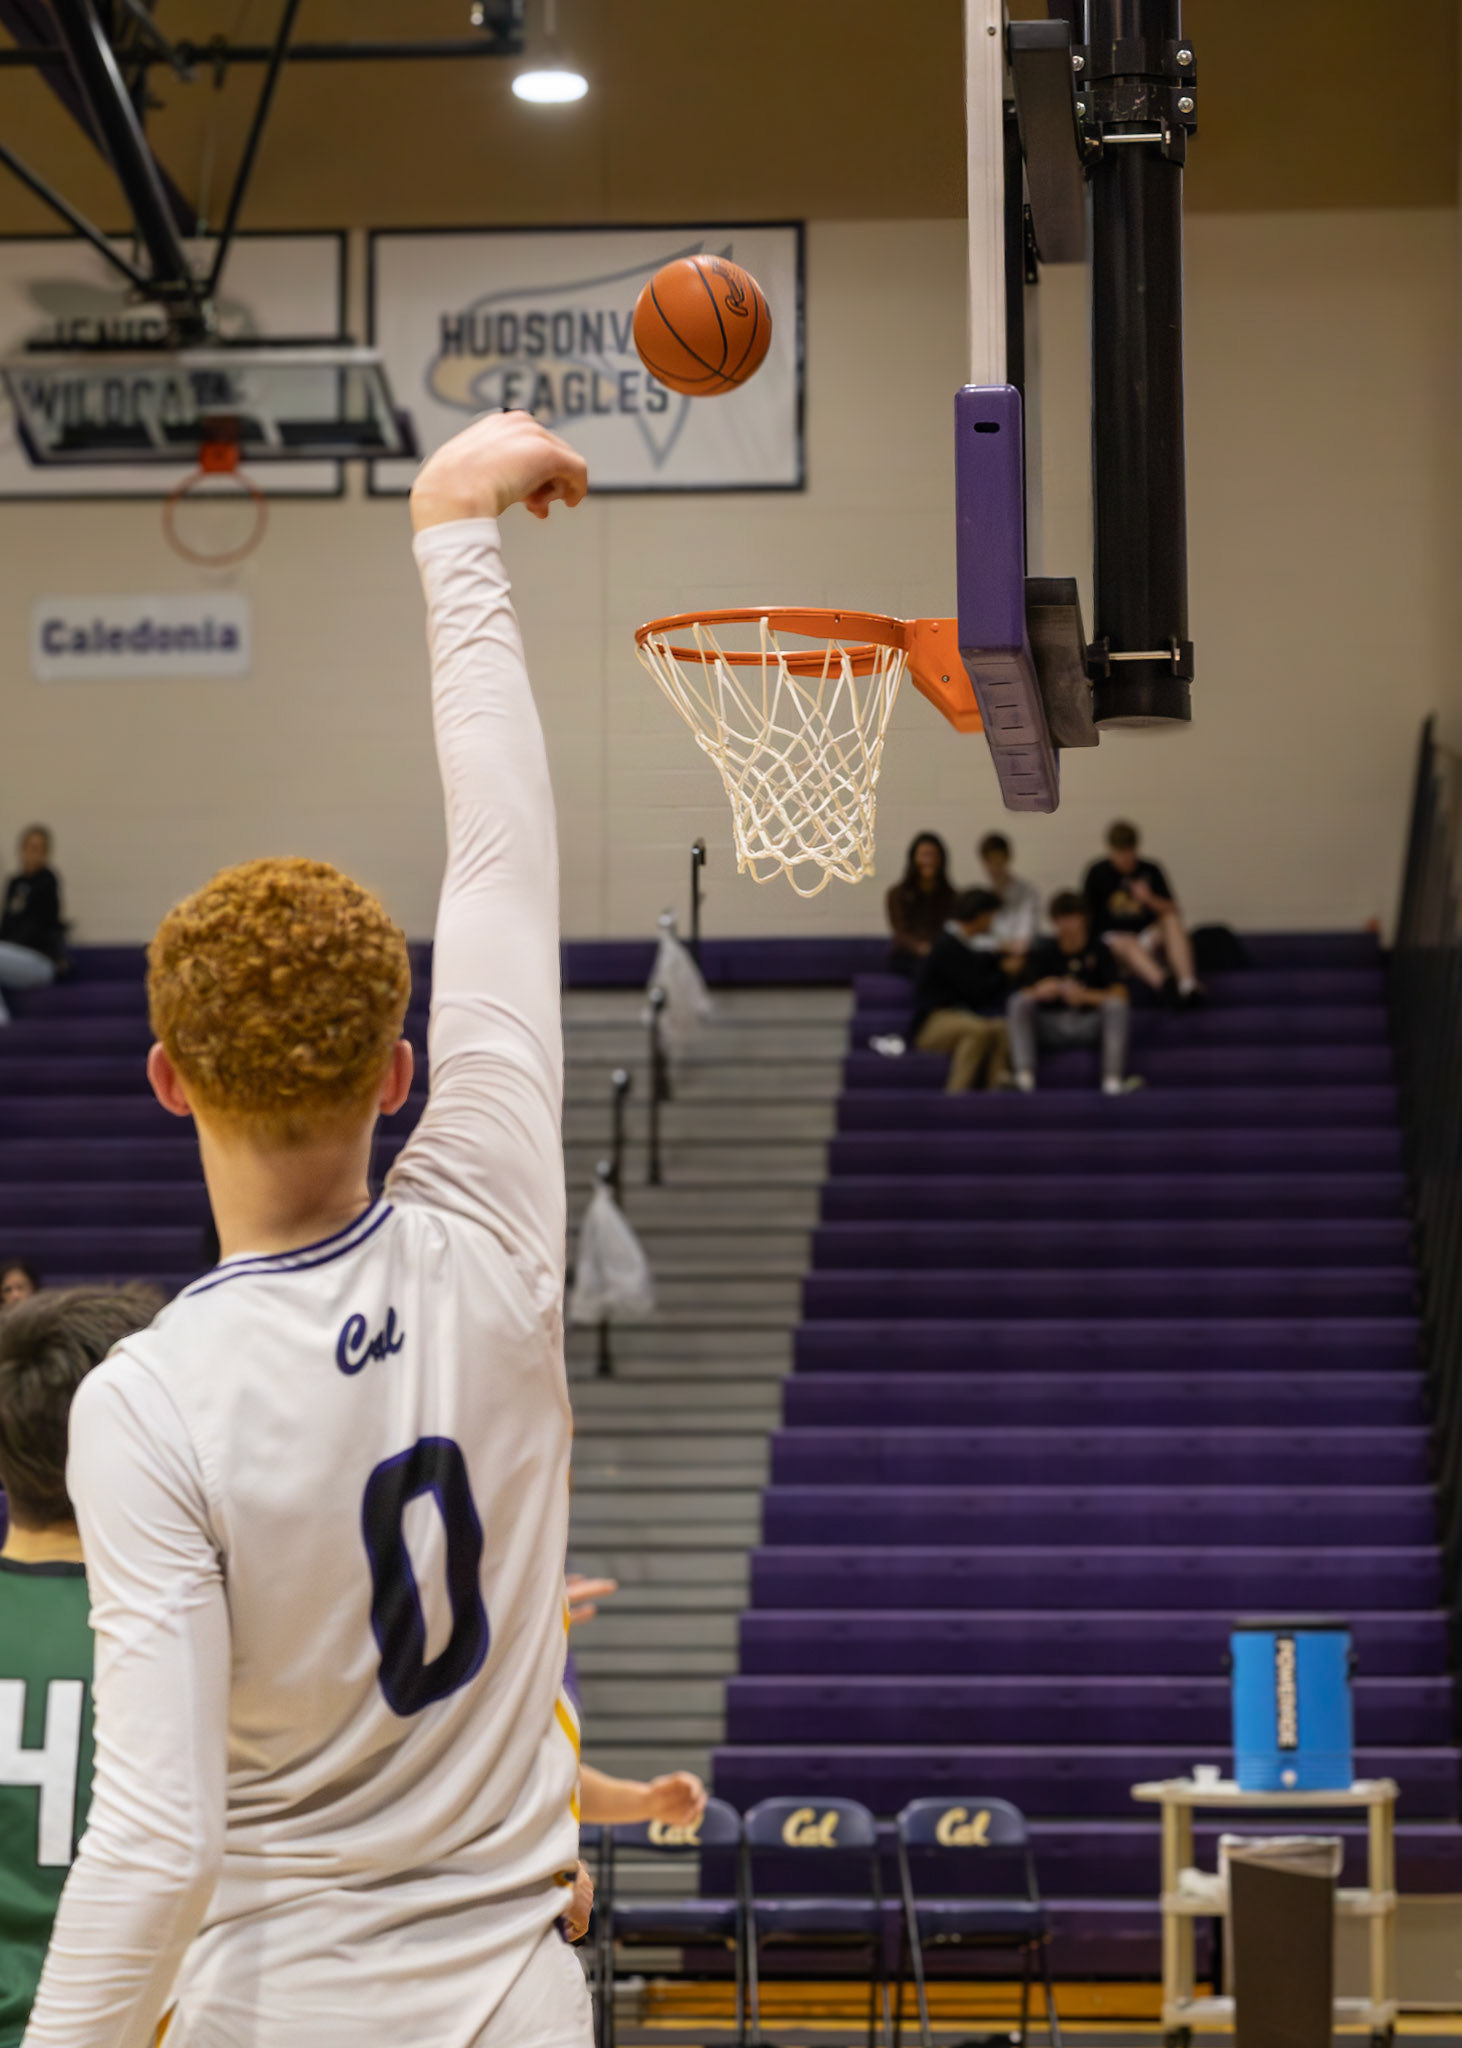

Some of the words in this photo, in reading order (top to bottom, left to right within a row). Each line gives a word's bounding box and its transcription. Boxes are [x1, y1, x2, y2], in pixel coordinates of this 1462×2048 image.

[438, 310, 634, 356] HUDSONV
[501, 368, 669, 414] EAGLES
[41, 616, 239, 655] Caledonia
[336, 1306, 405, 1375] Cal
[362, 1436, 491, 1717] 0
[0, 1678, 84, 1867] 4
[782, 1807, 838, 1847] Cal
[935, 1807, 991, 1847] Cal
